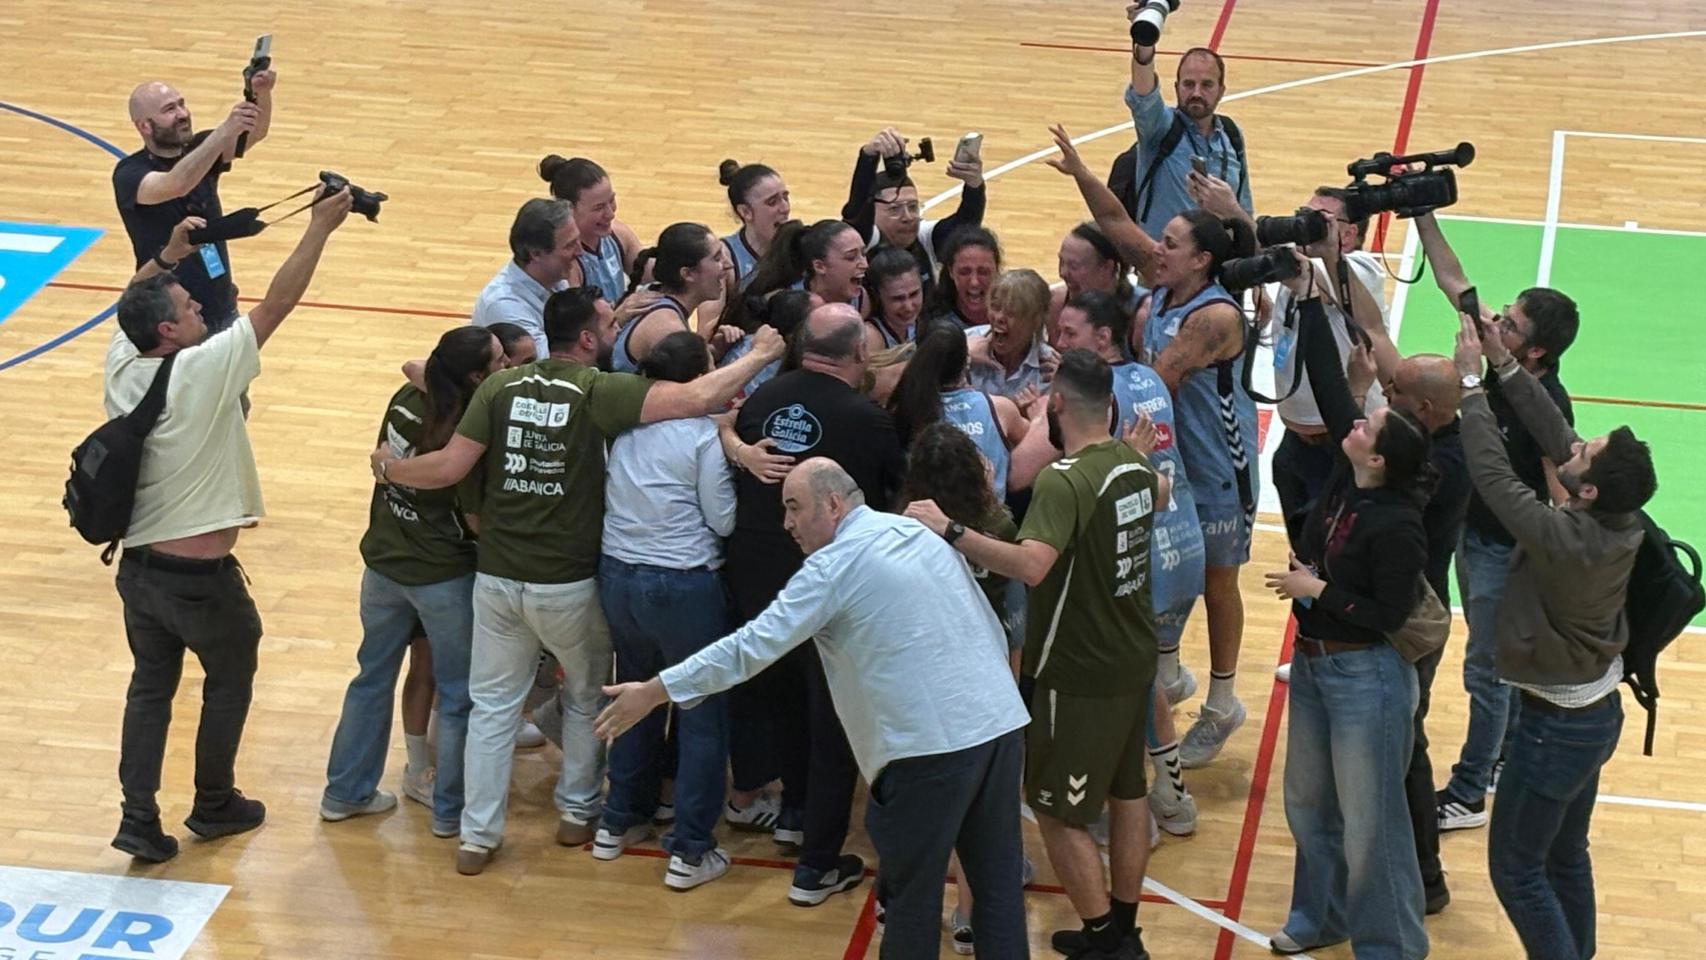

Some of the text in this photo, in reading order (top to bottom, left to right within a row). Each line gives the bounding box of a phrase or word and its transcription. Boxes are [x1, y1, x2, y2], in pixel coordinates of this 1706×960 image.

[773, 415, 812, 432] Estrella
[771, 426, 807, 443] Galicia
[0, 902, 174, 953] UR
